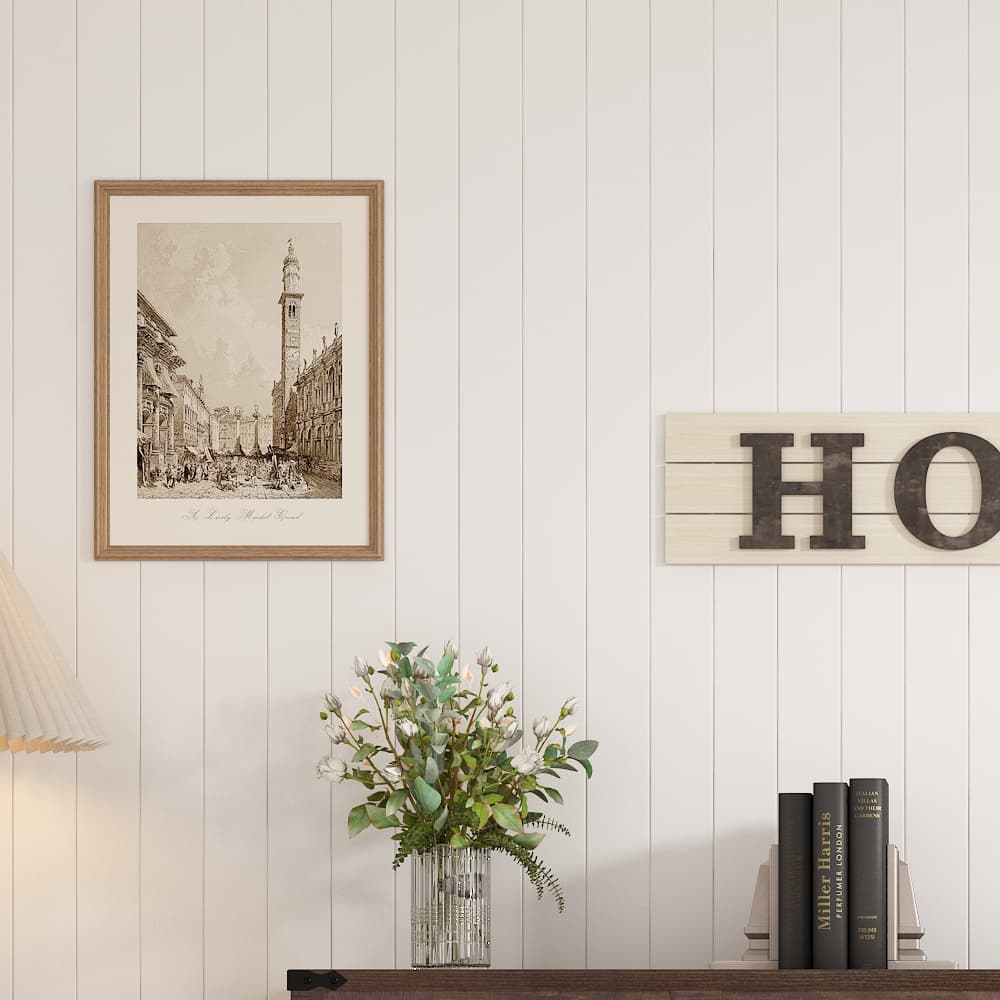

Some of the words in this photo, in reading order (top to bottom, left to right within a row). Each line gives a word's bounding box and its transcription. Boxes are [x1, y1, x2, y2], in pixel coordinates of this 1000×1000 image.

[817, 812, 831, 870] Harris
[835, 824, 843, 866] LONDON
[817, 876, 831, 931] Miller
[835, 870, 843, 919] PERFUMER
